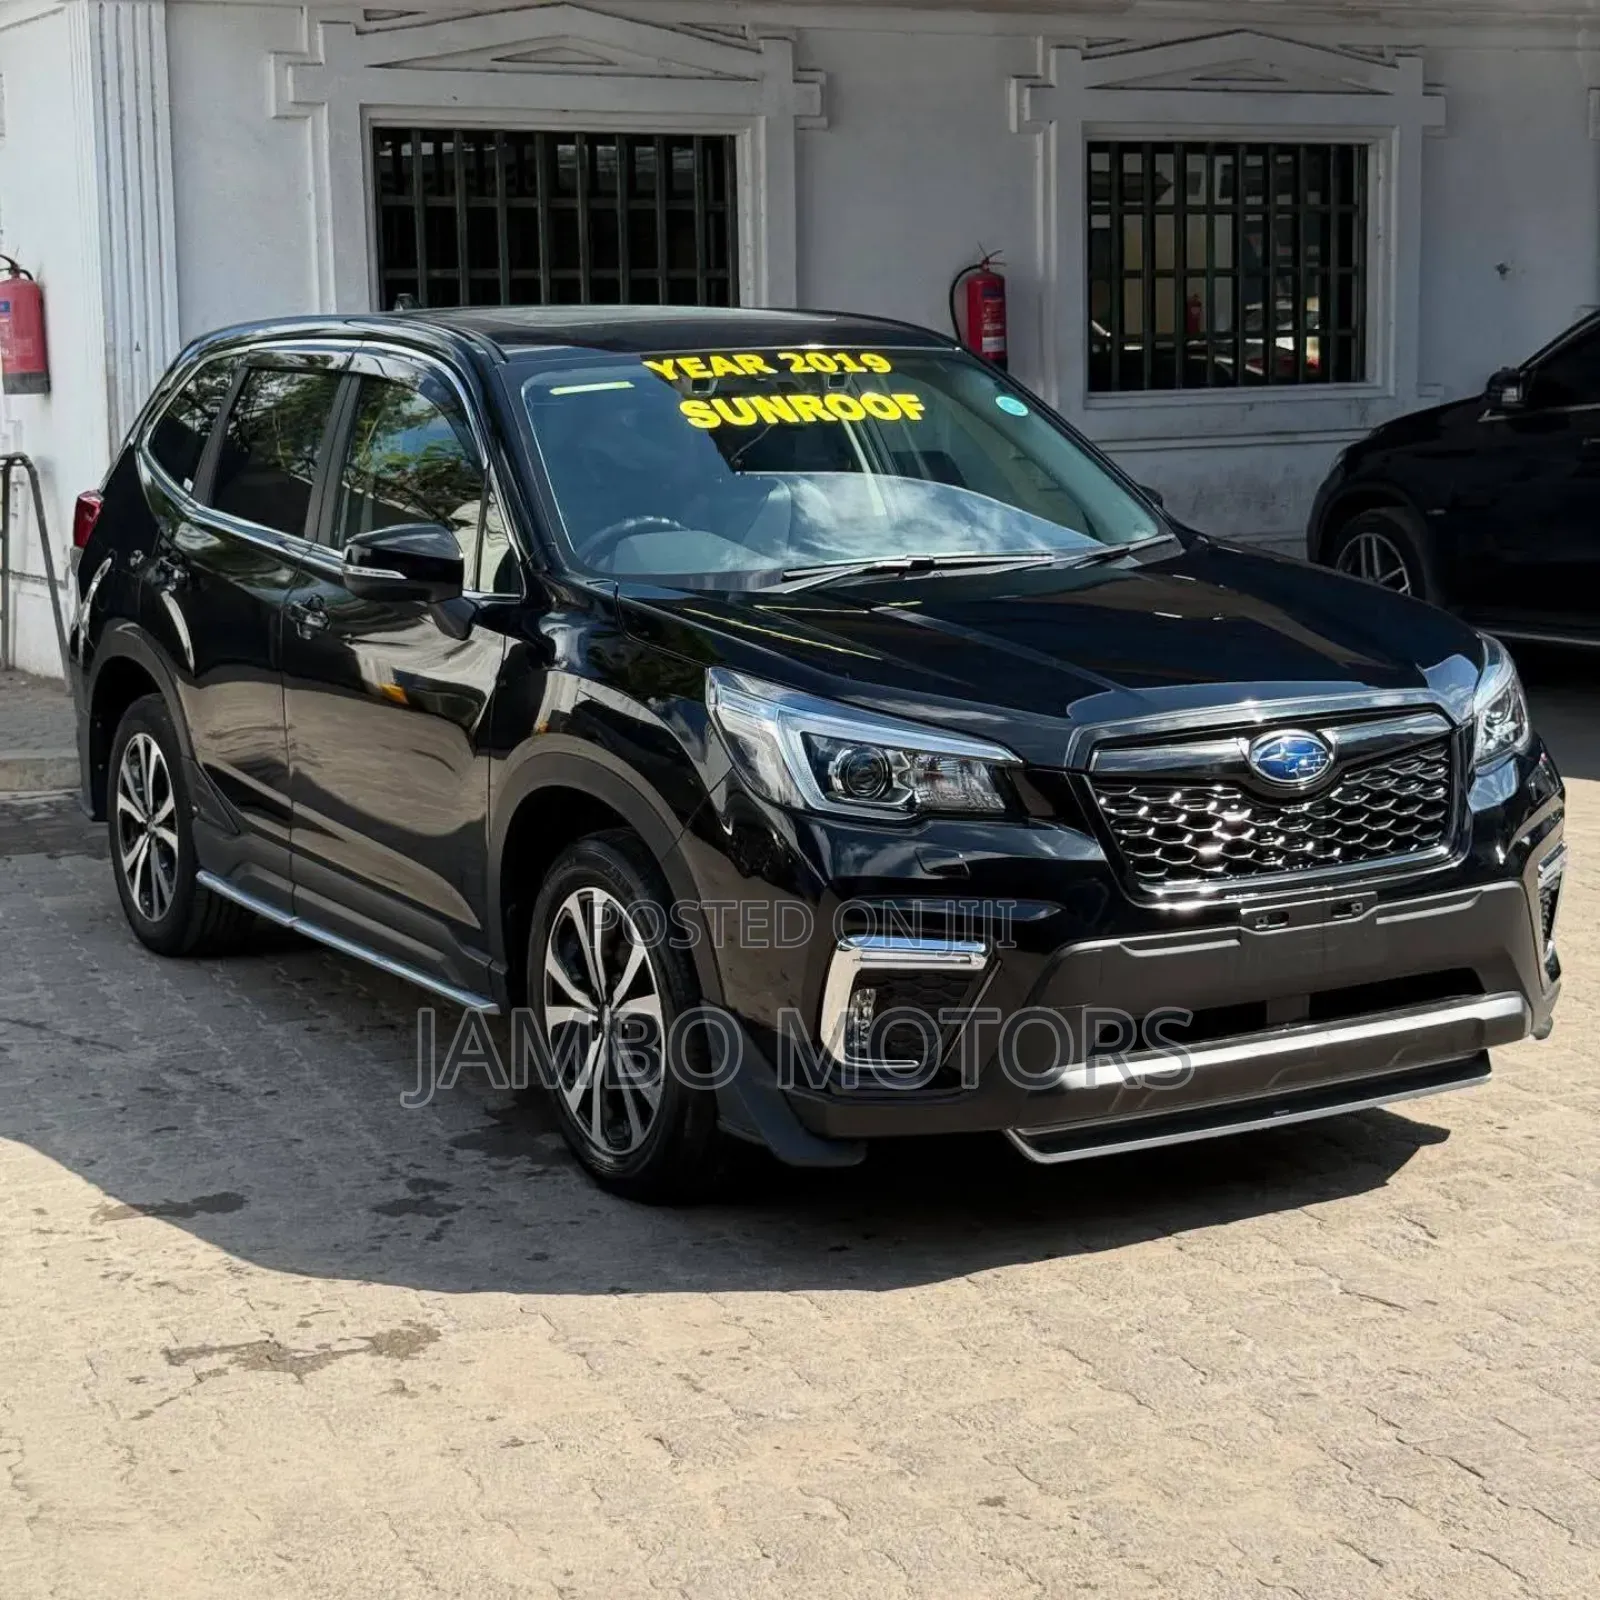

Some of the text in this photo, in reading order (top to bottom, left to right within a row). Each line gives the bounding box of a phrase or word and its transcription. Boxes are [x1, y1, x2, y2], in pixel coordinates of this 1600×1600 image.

[641, 352, 892, 381] YEAR 2019
[679, 392, 925, 429] SUNROOF
